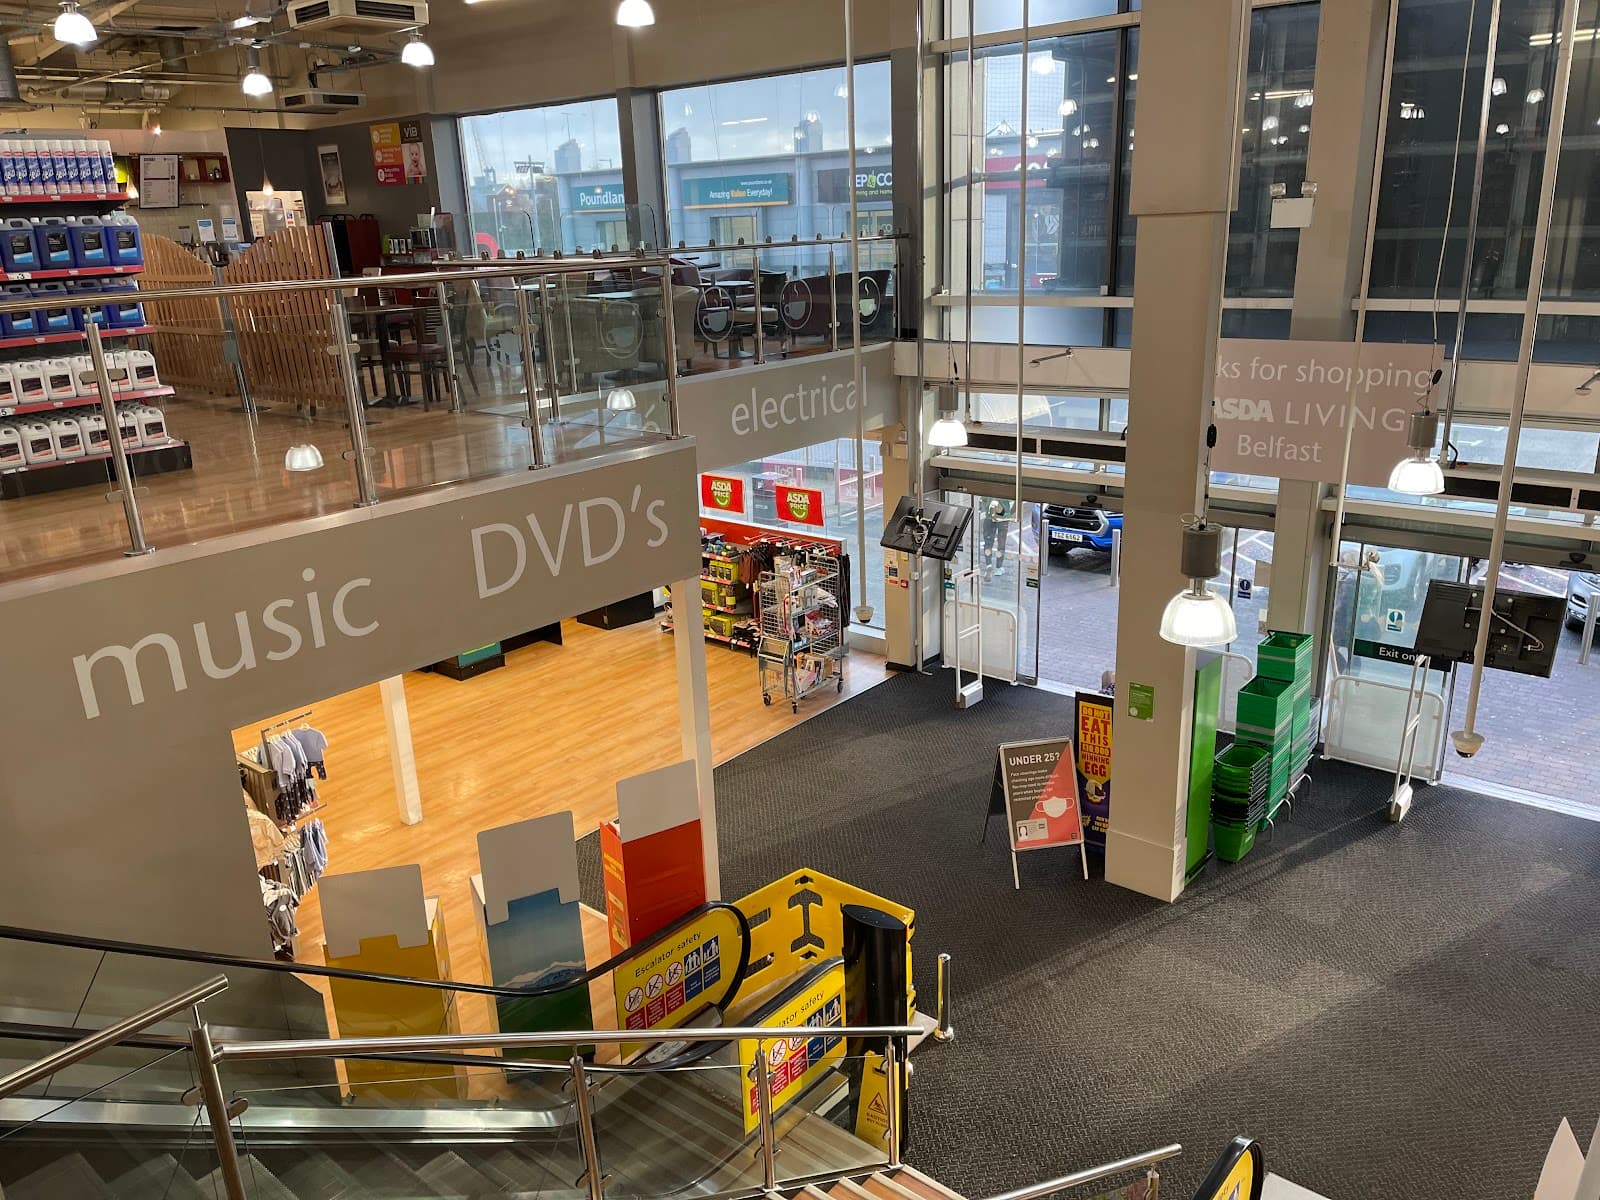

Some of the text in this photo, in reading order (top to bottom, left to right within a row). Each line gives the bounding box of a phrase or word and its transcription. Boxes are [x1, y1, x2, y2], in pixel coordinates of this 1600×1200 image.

[849, 171, 892, 189] EP&CO
[580, 191, 625, 206] Poundlan
[1250, 356, 1288, 381] for
[1296, 358, 1432, 396] shopping
[731, 366, 868, 436] electrical
[1285, 401, 1406, 431] LIVING
[1236, 434, 1323, 463] Belfast
[711, 481, 732, 492] ASDA
[713, 490, 730, 498] PRICE
[786, 493, 810, 505] ASDA
[790, 502, 808, 510] PRICE
[72, 567, 380, 720] music
[1378, 646, 1399, 659] Exit
[1094, 709, 1109, 720] NOT
[1081, 716, 1111, 736] EAT
[1082, 732, 1109, 746] THIS
[1009, 751, 1060, 766] UNDER 25?
[1081, 751, 1110, 765] WINNING
[1084, 761, 1107, 778] EGG
[635, 931, 701, 978] Escalator safety
[800, 990, 825, 1014] safety
